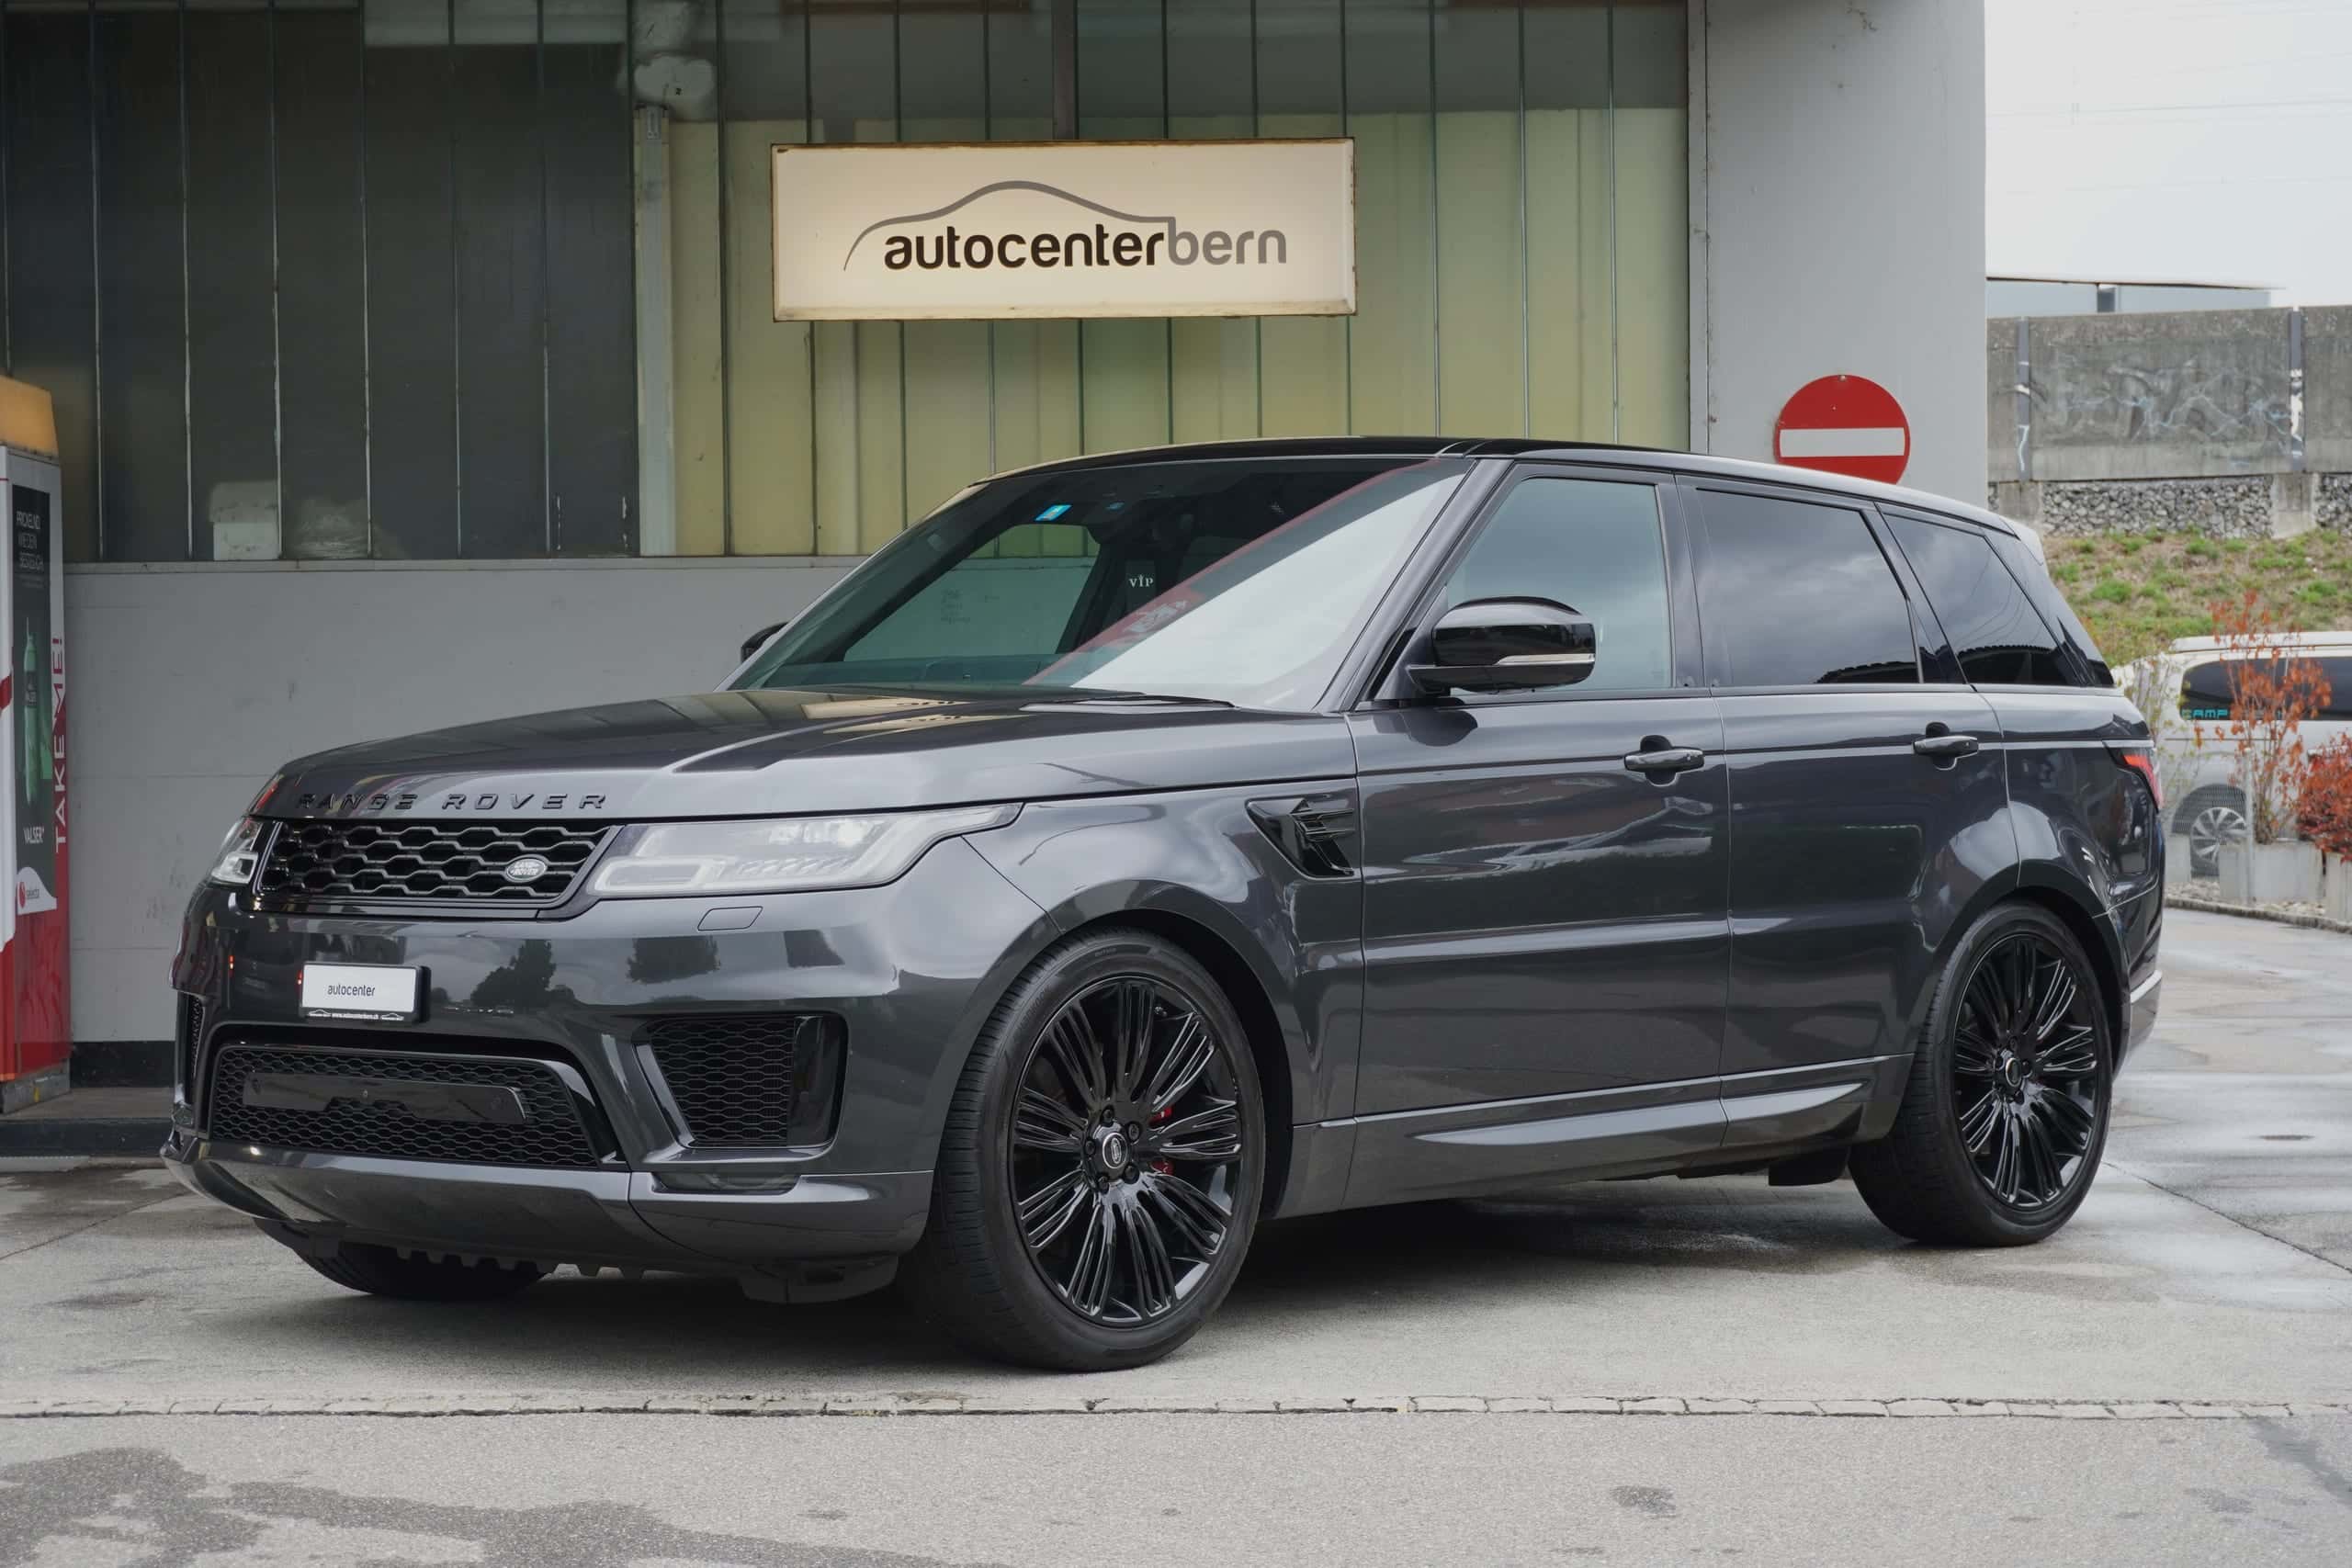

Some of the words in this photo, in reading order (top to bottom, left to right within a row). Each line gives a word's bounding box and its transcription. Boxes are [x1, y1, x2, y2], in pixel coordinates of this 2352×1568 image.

[54, 735, 66, 853] TAKE
[296, 793, 418, 810] RANGE
[442, 793, 606, 810] ROVER
[327, 983, 376, 998] autocenter
